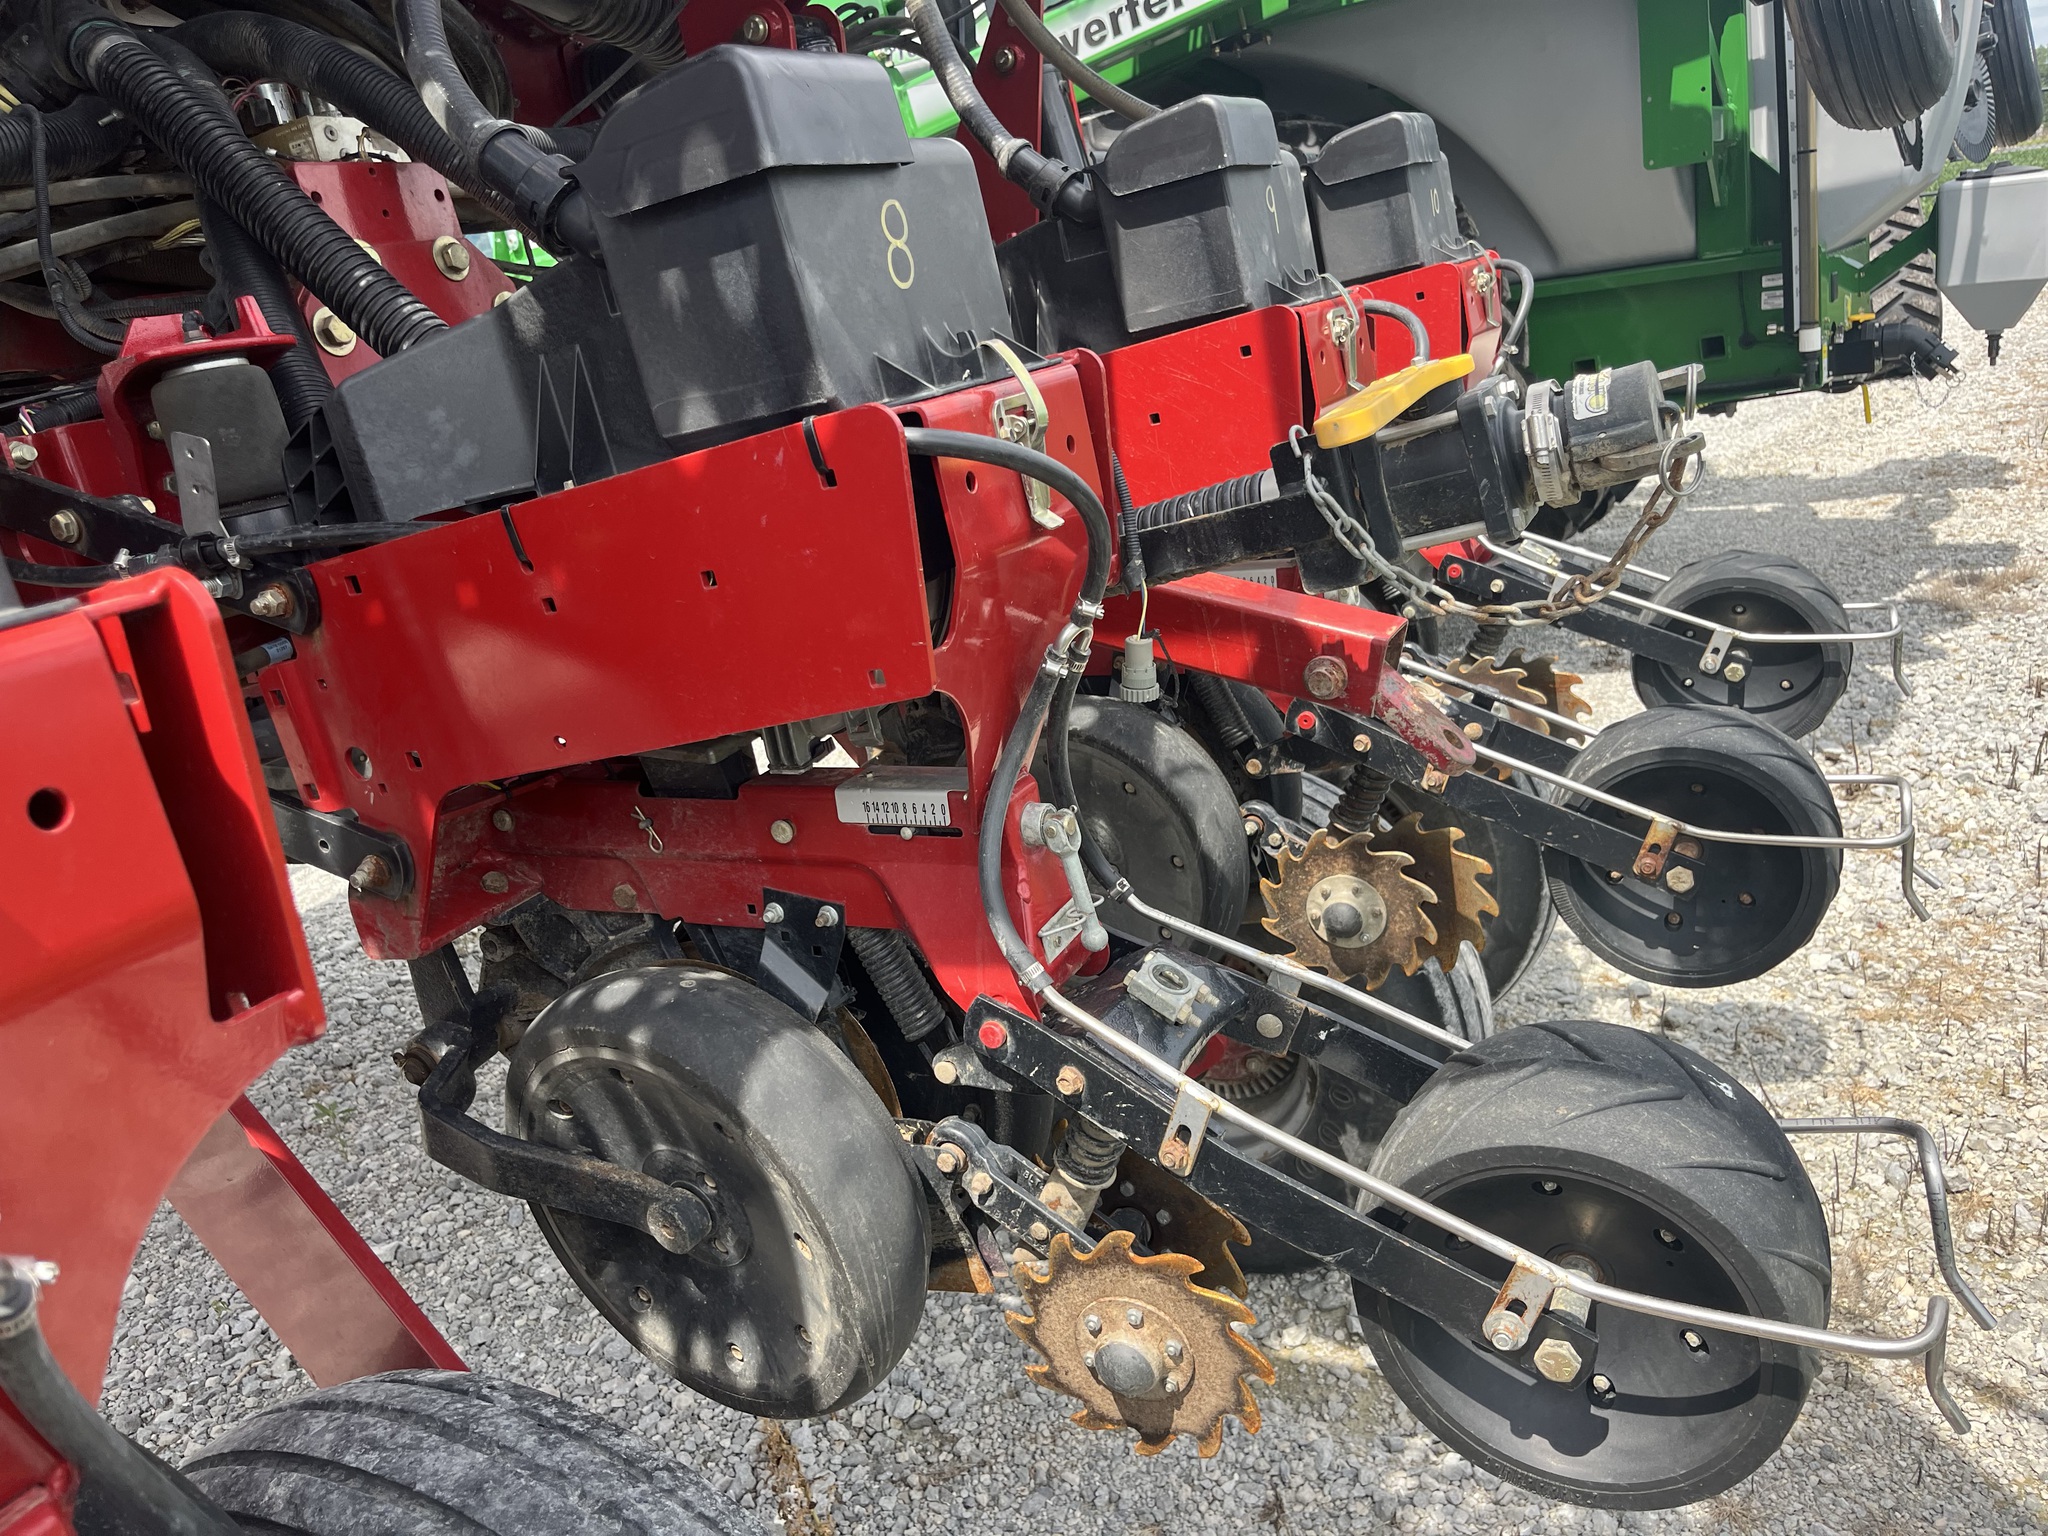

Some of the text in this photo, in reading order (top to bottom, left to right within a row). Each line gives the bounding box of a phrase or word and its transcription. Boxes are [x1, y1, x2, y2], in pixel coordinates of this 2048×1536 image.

[1059, 0, 1184, 56] verfe
[1265, 184, 1280, 235] 9
[1430, 188, 1440, 217] 10
[881, 199, 915, 290] 8
[862, 801, 946, 815] 16 14 12 10 8 6 4 2 0
